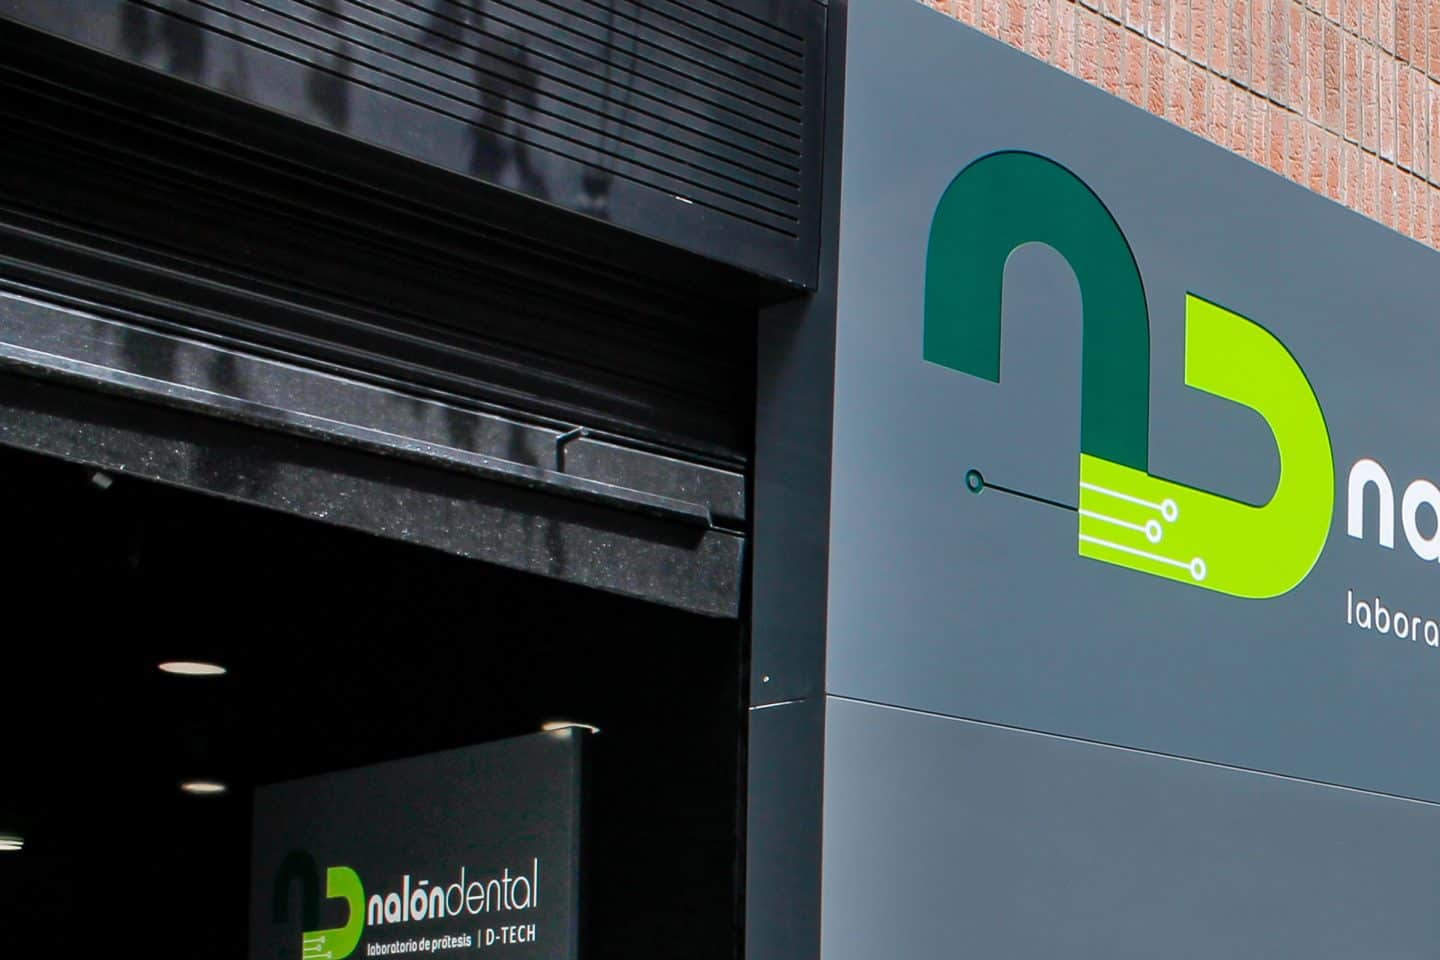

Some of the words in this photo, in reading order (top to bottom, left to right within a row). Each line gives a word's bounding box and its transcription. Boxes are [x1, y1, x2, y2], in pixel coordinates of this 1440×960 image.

[367, 938, 417, 957] laboratorio
[418, 937, 431, 952] de
[485, 923, 536, 946] D-TECH
